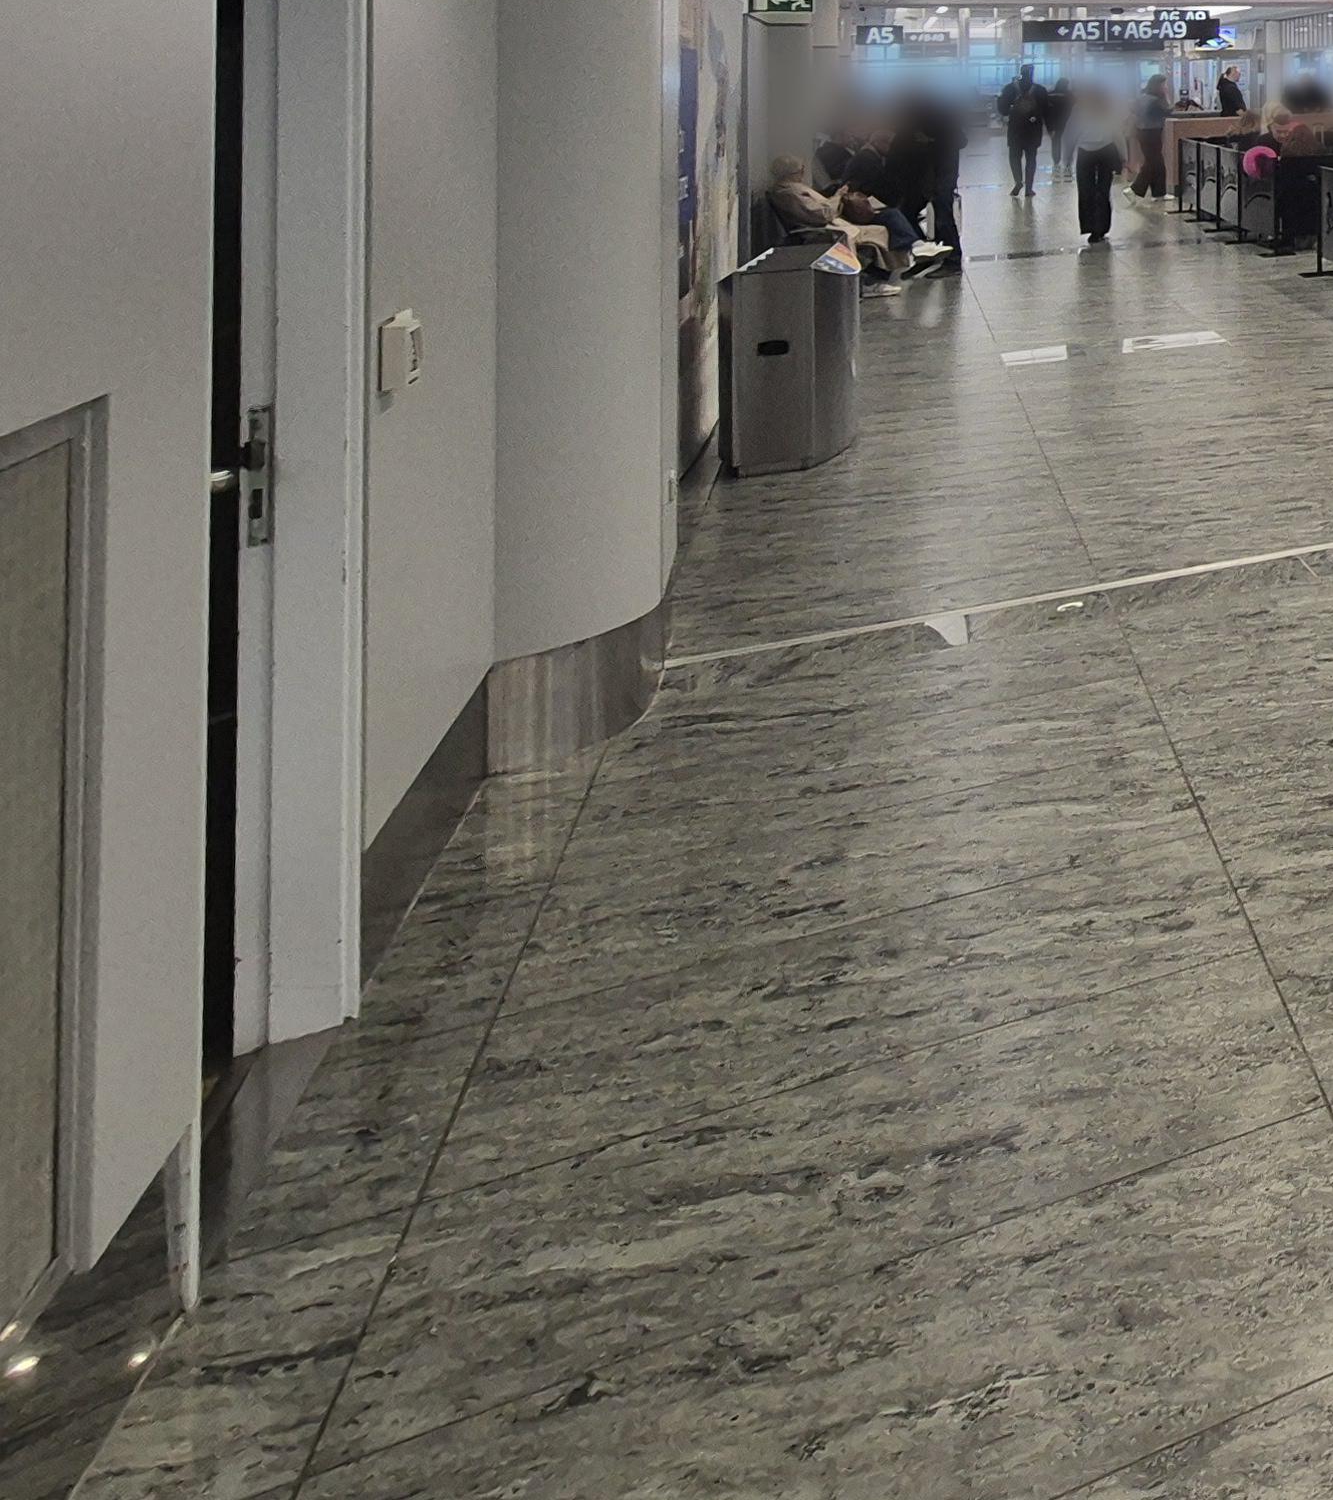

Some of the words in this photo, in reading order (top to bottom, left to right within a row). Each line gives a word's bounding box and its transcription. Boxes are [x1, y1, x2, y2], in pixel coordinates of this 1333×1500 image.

[866, 26, 895, 44] A5
[1071, 21, 1100, 40] A5
[1124, 20, 1188, 40] A6-A9
